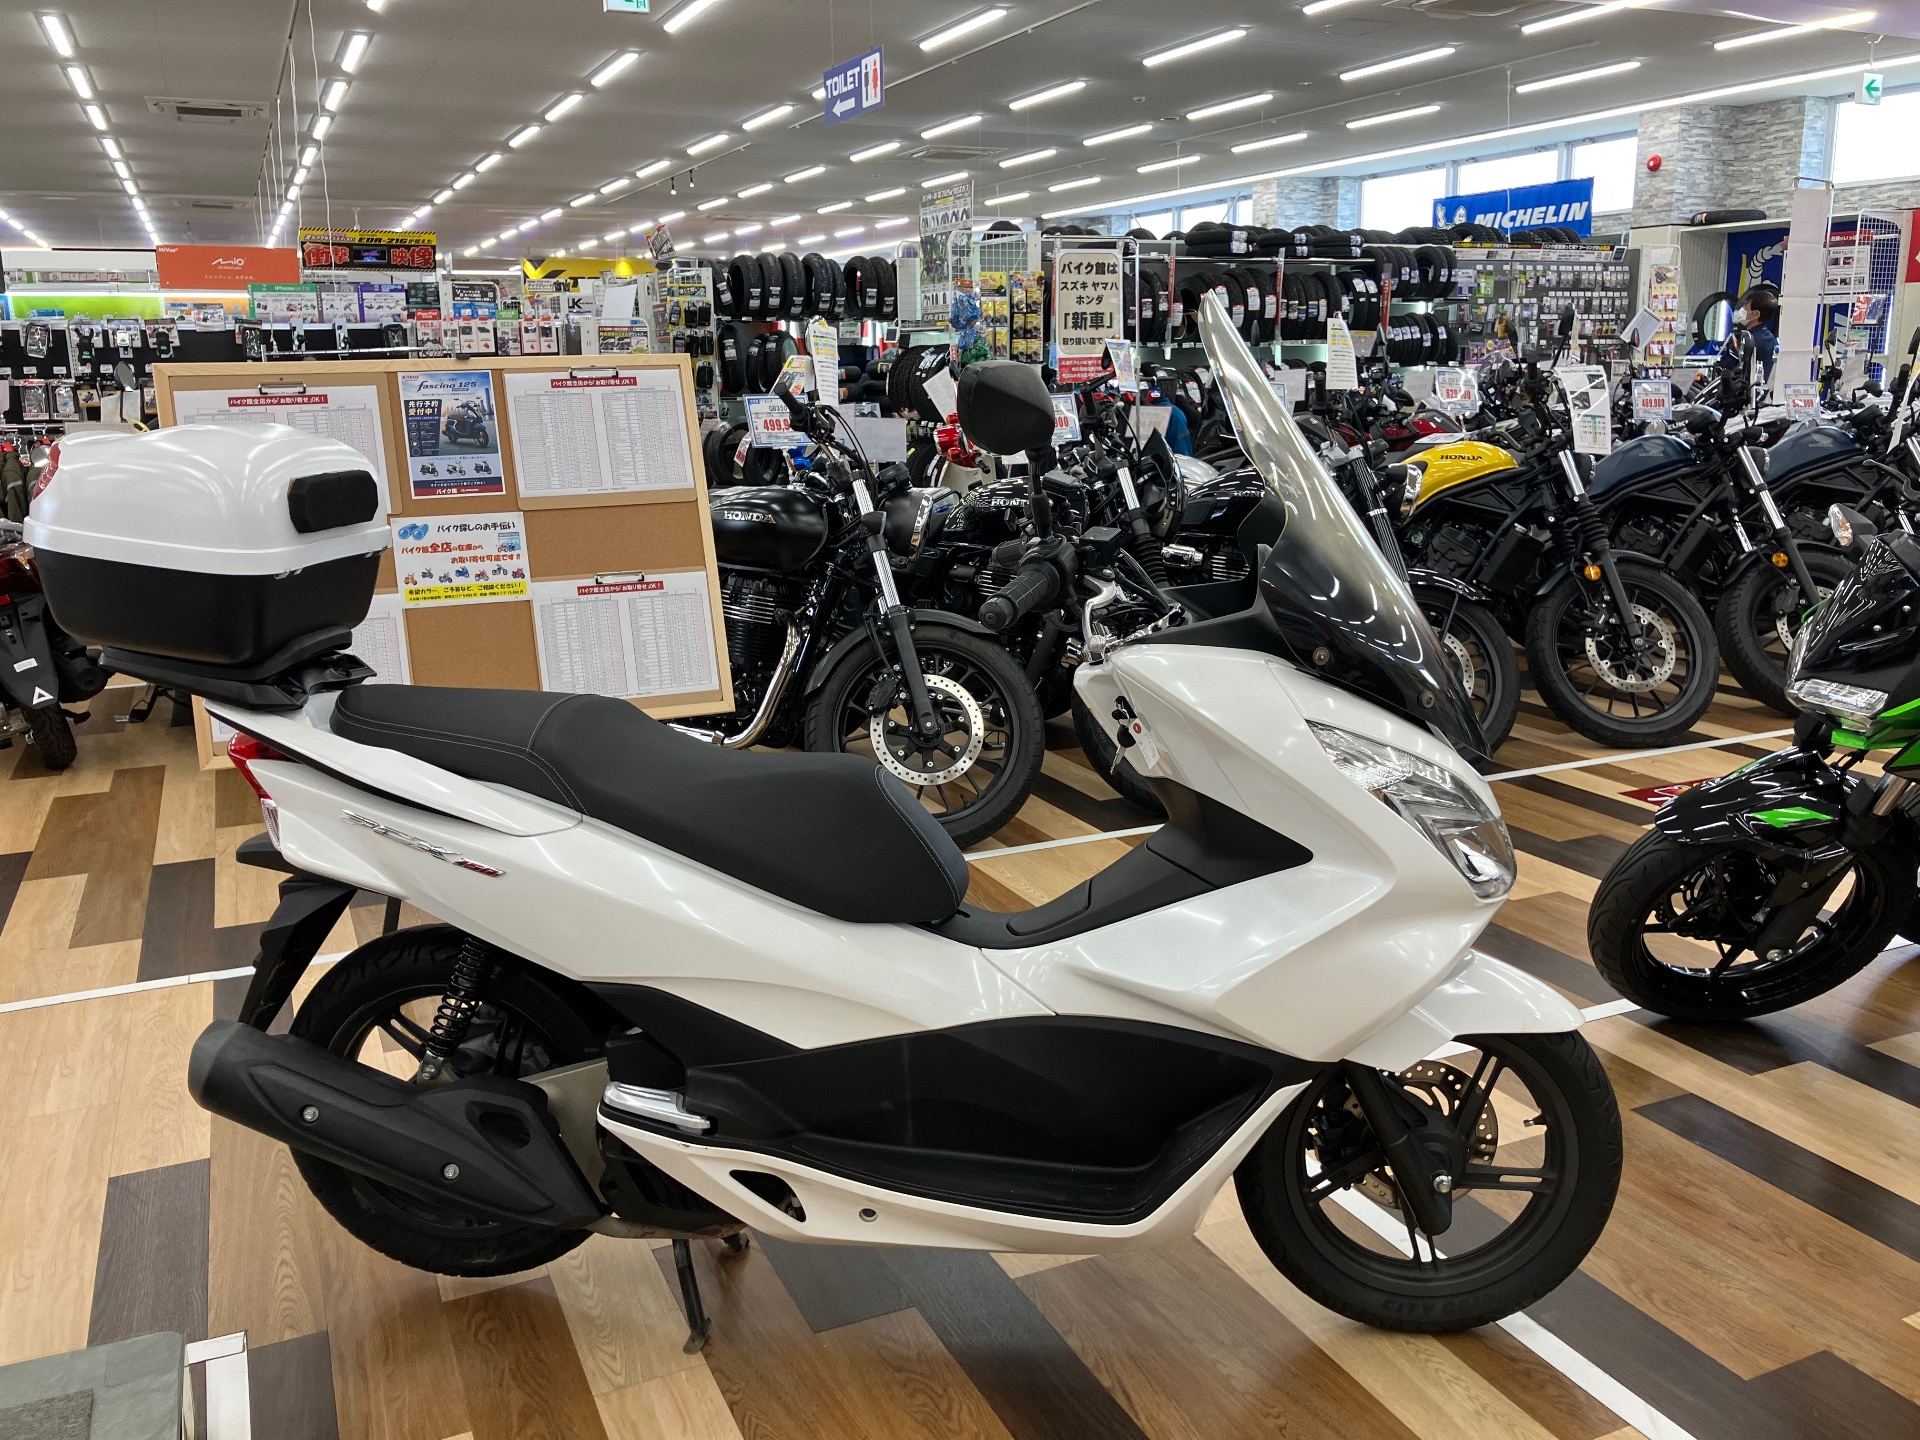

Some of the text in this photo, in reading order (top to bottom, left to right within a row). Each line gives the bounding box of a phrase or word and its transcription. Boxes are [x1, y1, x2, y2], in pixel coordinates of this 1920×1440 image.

[825, 66, 861, 99] TOILET
[1474, 201, 1589, 231] MICHELIN
[390, 246, 435, 268] 映像
[1060, 261, 1118, 276] バイク館は
[1060, 281, 1119, 291] スズキ ヤマハ
[1075, 295, 1104, 305] ホンダ
[1063, 311, 1113, 331] 「新車」
[1062, 336, 1107, 346] 取り扱い店で
[417, 380, 456, 392] fascino
[408, 408, 437, 416] 受付中！
[1441, 454, 1483, 462] HONDA
[724, 511, 777, 524] HONDA
[437, 521, 516, 533] バイク探しのお手伝い
[401, 542, 484, 555] バイク館全店の在庫から
